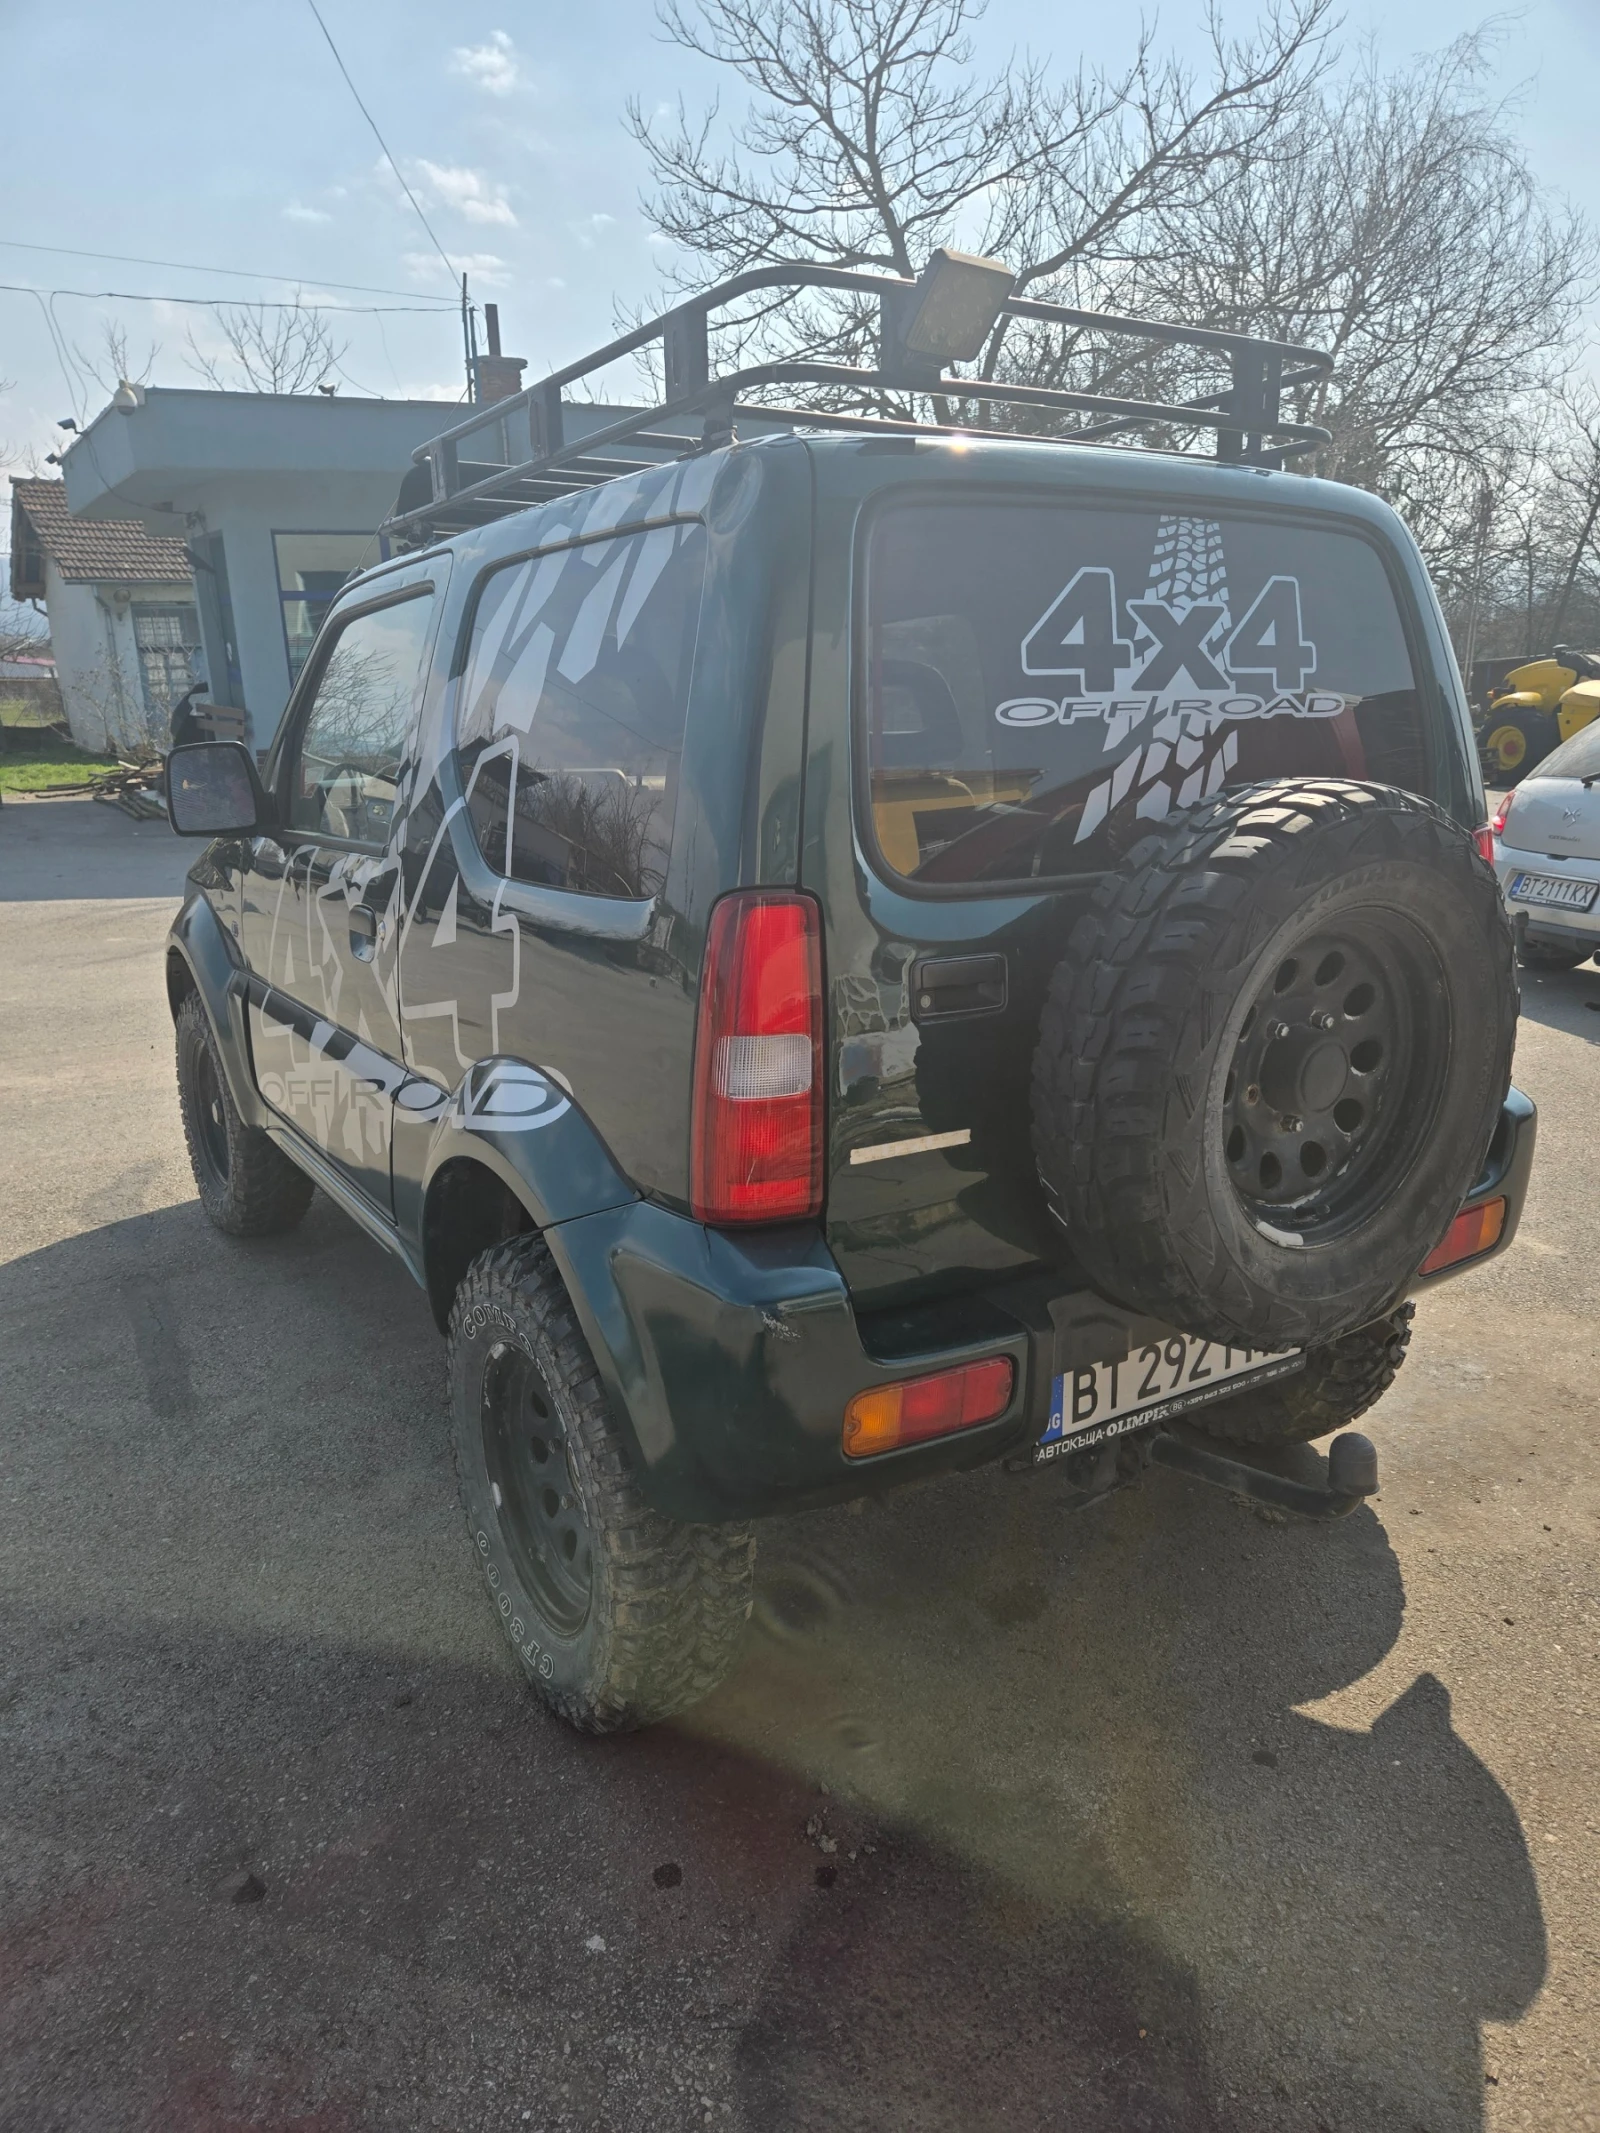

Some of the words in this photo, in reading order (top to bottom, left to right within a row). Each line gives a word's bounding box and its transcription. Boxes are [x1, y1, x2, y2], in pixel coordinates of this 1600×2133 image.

[996, 697, 1150, 726] OFF
[1168, 693, 1346, 720] ROAD
[262, 1078, 336, 1109] OFF
[1037, 1429, 1103, 1462] АВТОКЪЩА
